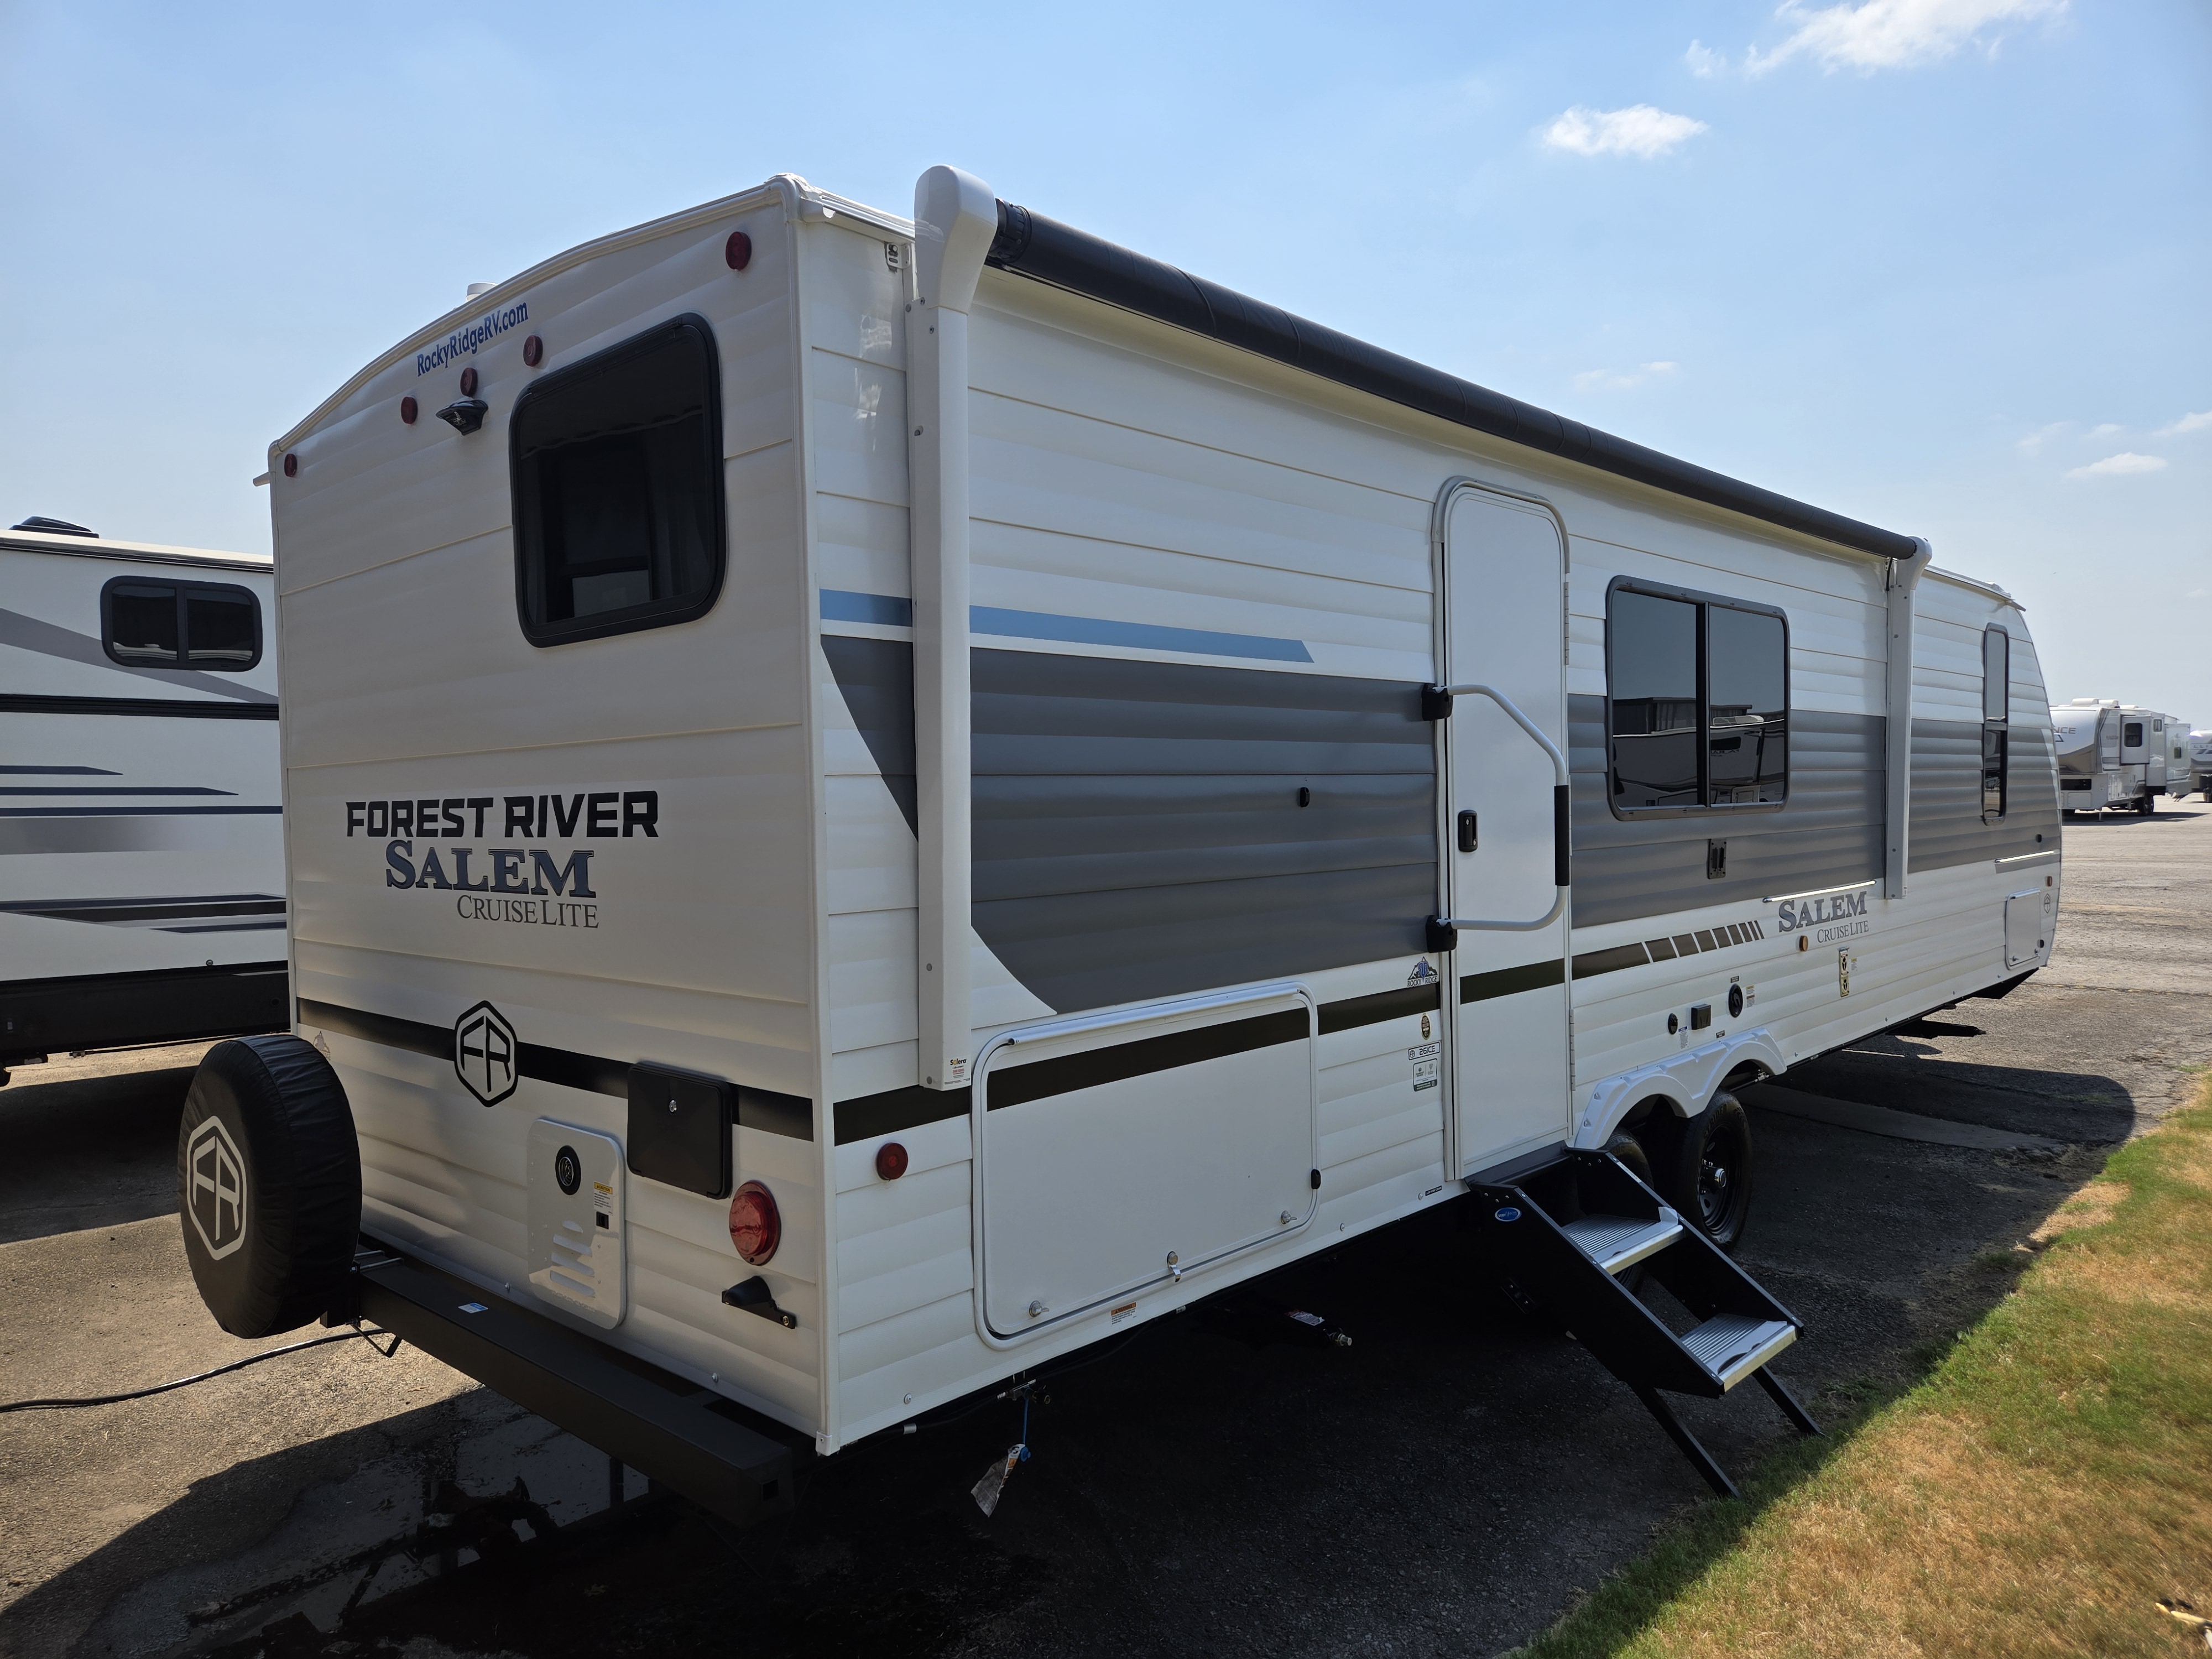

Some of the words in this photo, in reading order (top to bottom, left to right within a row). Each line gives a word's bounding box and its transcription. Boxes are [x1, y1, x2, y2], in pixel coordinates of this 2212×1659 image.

[417, 302, 529, 377] RockyRidgeRV.com
[346, 797, 493, 838] FOREST
[503, 791, 659, 838] RIVER
[386, 839, 596, 898] SALEM
[1778, 891, 1867, 932] SALEM
[1407, 979, 1422, 987] ROCKY
